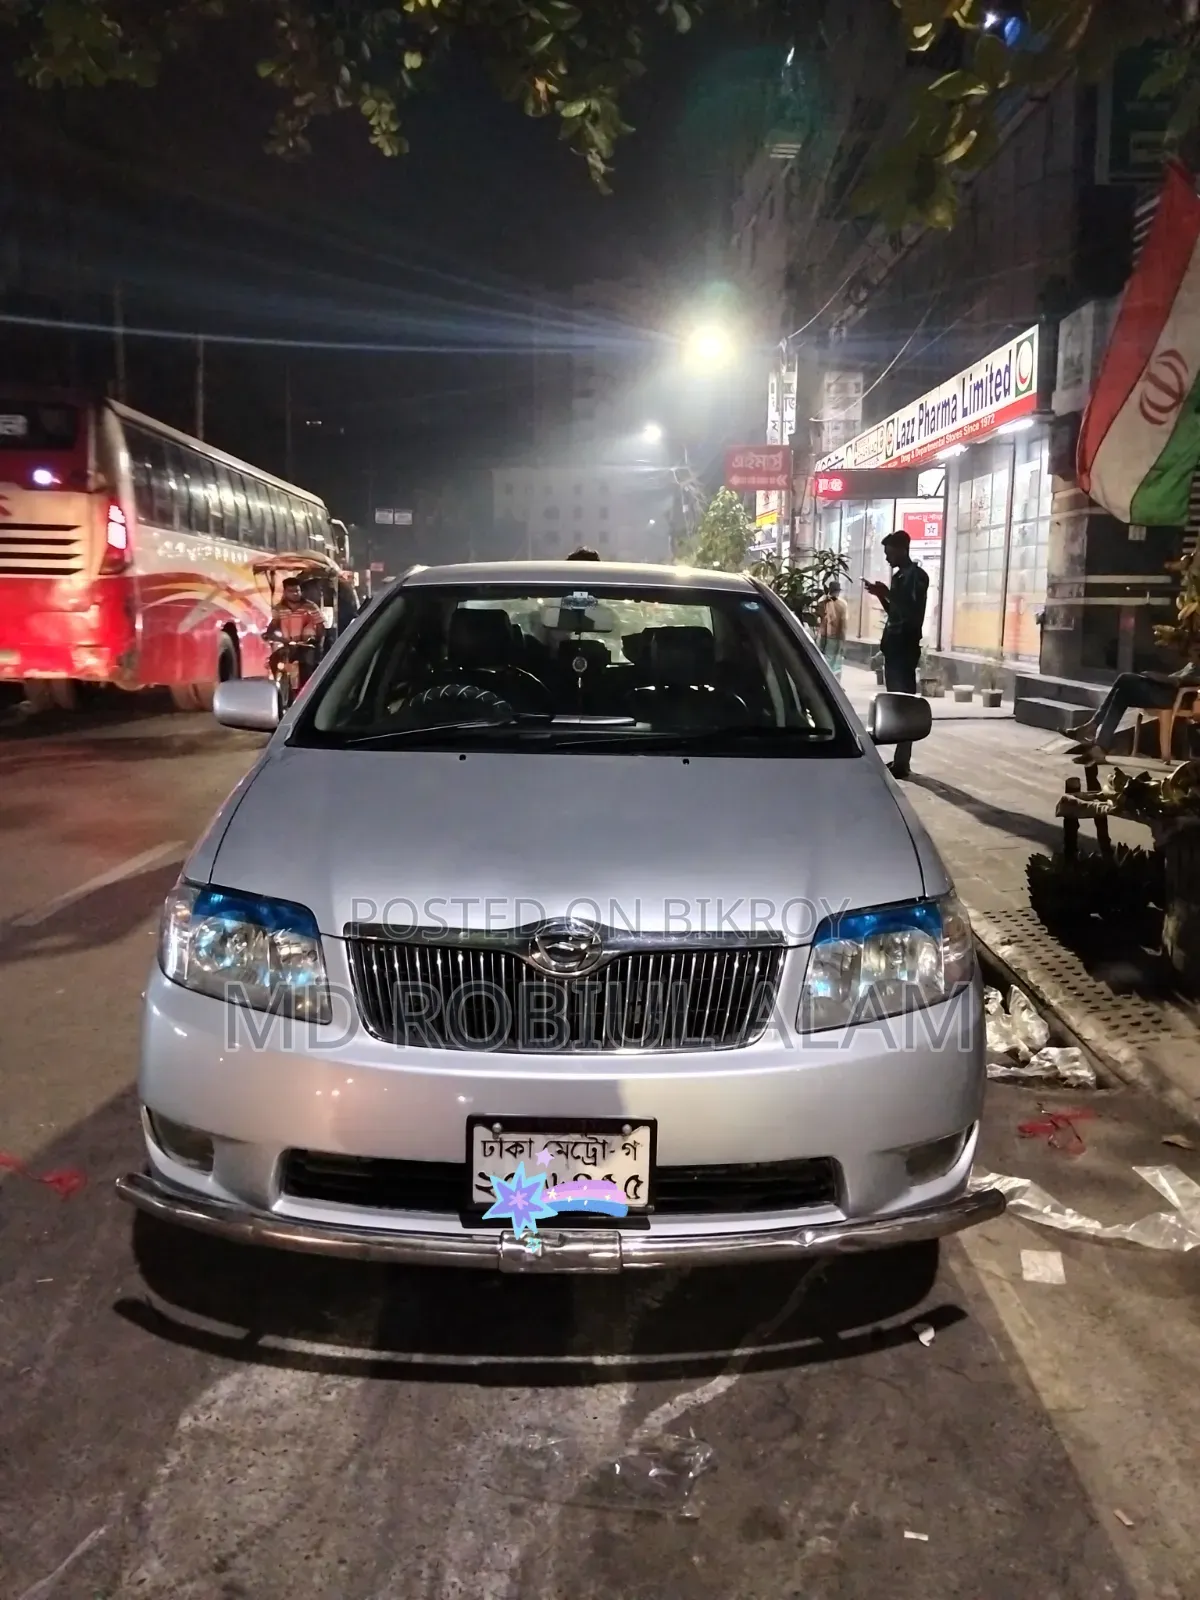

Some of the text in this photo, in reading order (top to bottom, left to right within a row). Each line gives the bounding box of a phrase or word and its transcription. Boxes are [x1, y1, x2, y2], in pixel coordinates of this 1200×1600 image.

[895, 416, 916, 451] Lazz
[918, 392, 958, 441] Pharma
[961, 349, 1013, 419] Limited
[945, 430, 963, 444] Stores
[963, 421, 980, 435] Since
[980, 413, 995, 428] 1972
[480, 1137, 535, 1160] ঢাকা
